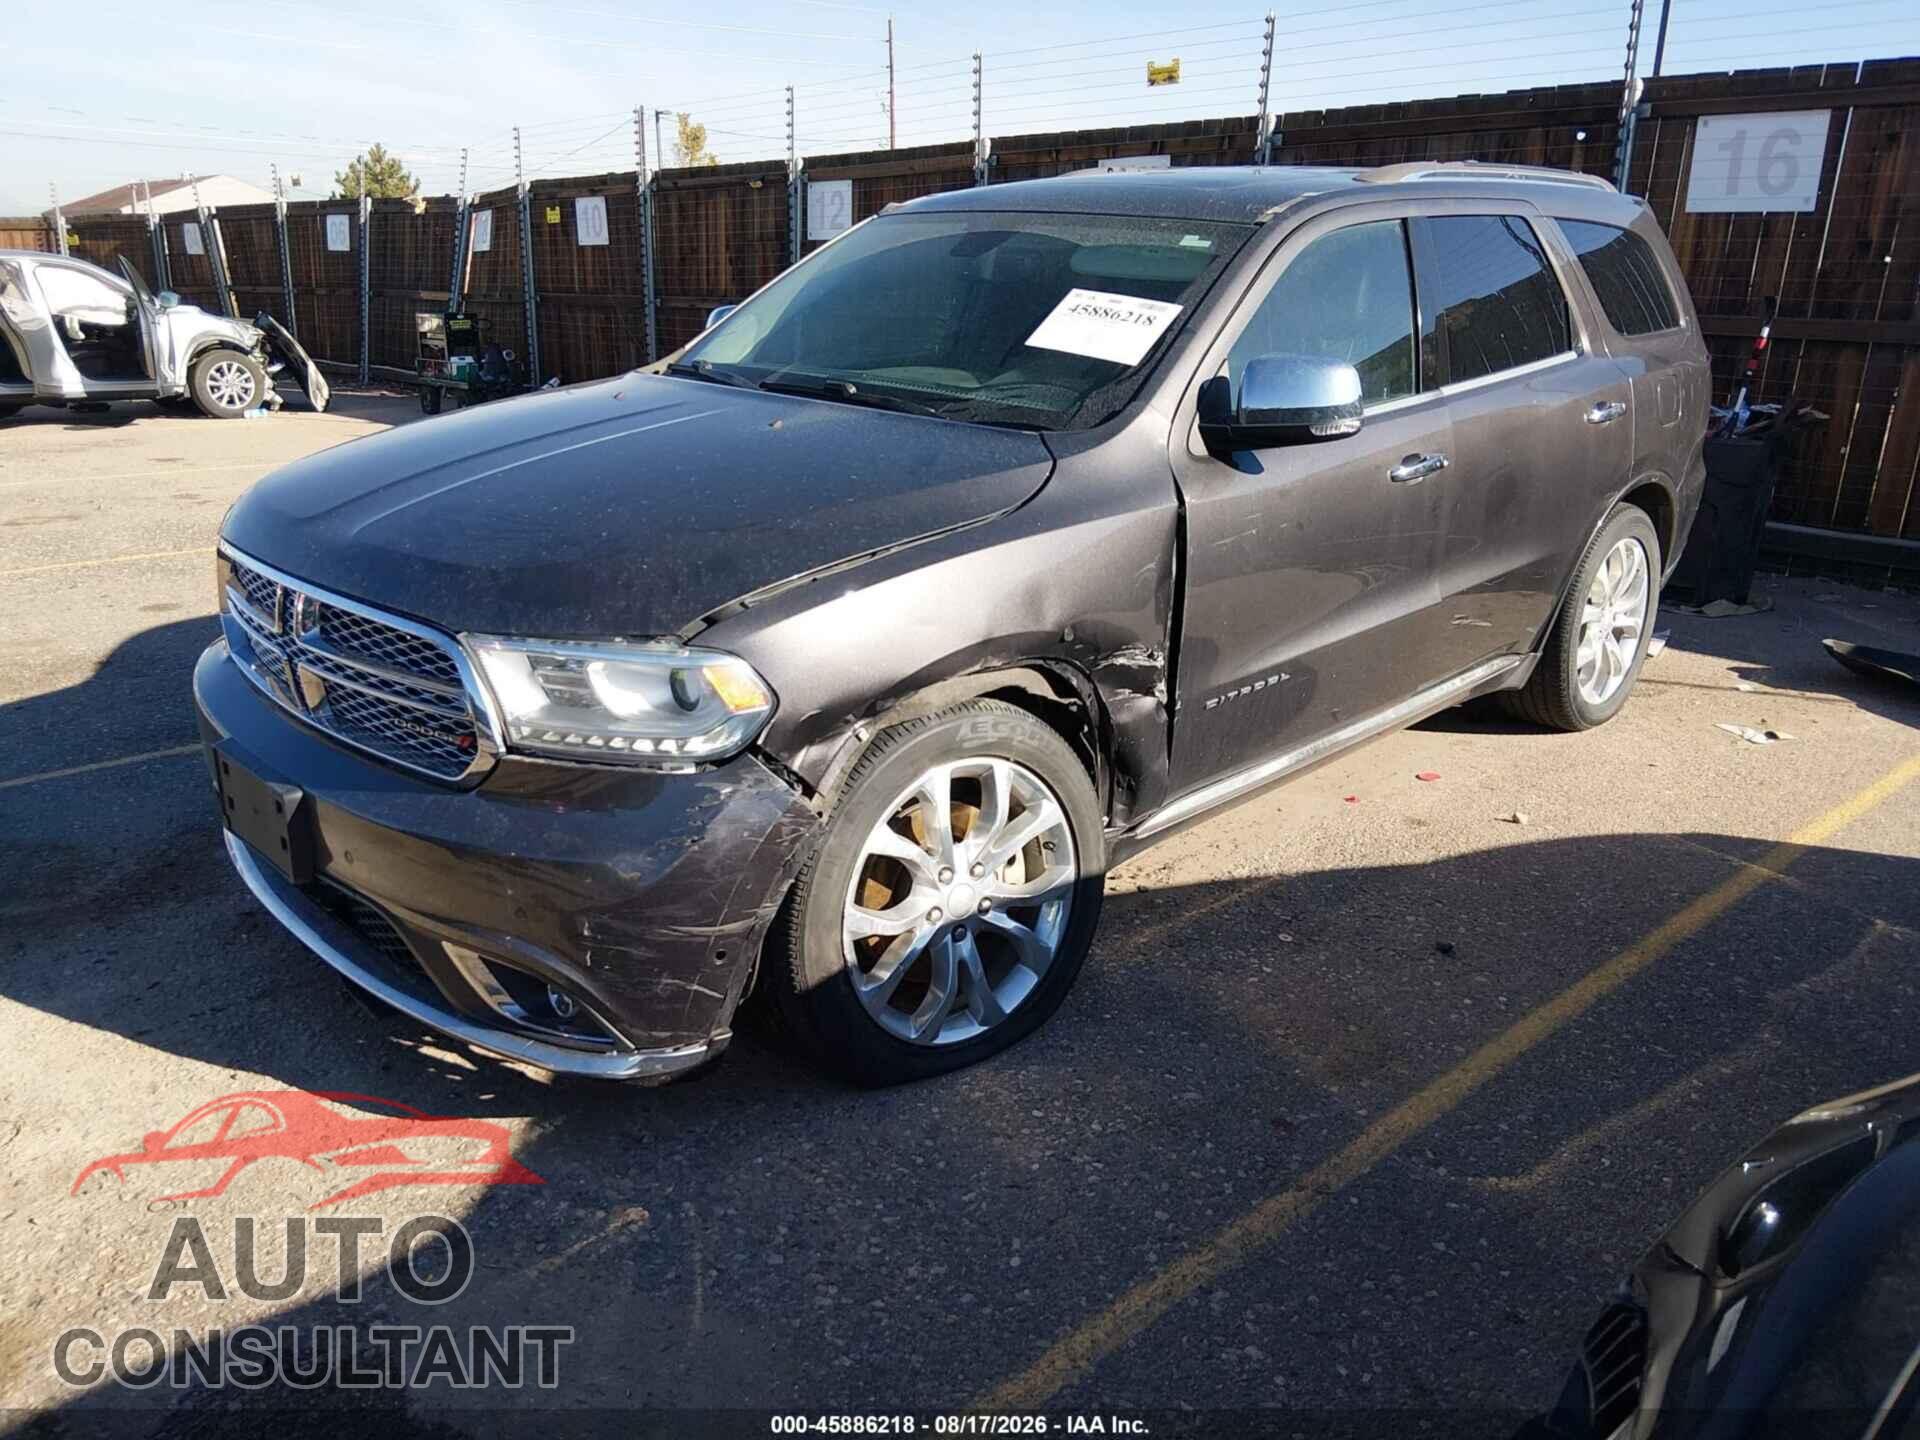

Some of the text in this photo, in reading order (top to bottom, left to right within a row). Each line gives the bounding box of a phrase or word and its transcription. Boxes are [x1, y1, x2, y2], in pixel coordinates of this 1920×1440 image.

[1717, 128, 1802, 196] 16
[581, 203, 603, 237] 10
[815, 188, 845, 229] 12
[1068, 303, 1157, 327] 45886218
